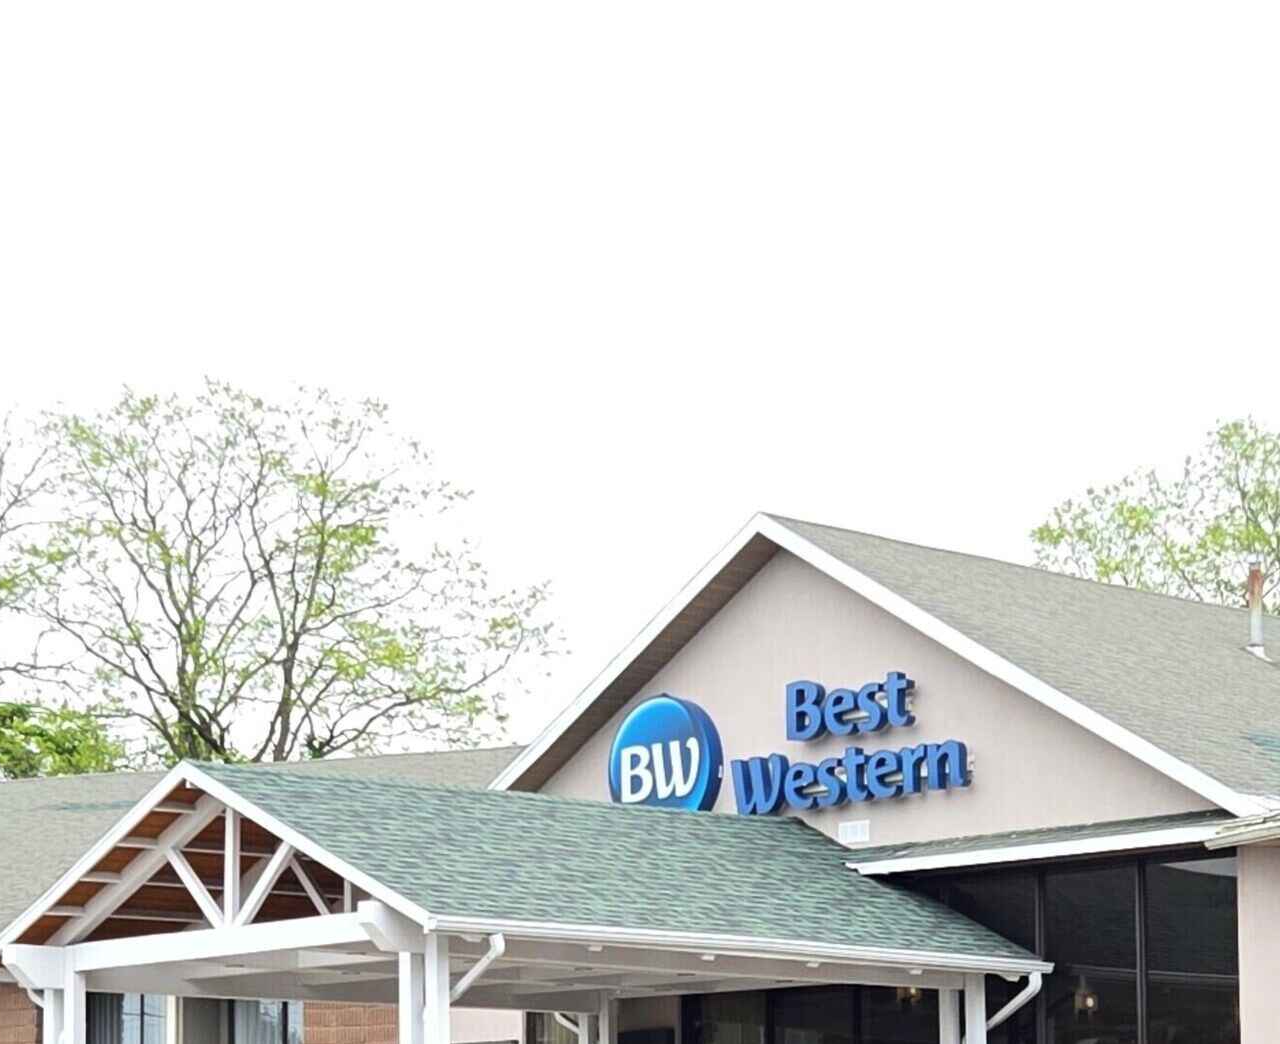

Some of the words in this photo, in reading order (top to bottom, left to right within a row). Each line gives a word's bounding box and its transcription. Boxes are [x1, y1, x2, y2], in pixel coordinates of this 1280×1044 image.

[786, 671, 916, 741] Best
[620, 736, 701, 804] BW
[730, 740, 968, 816] Western
